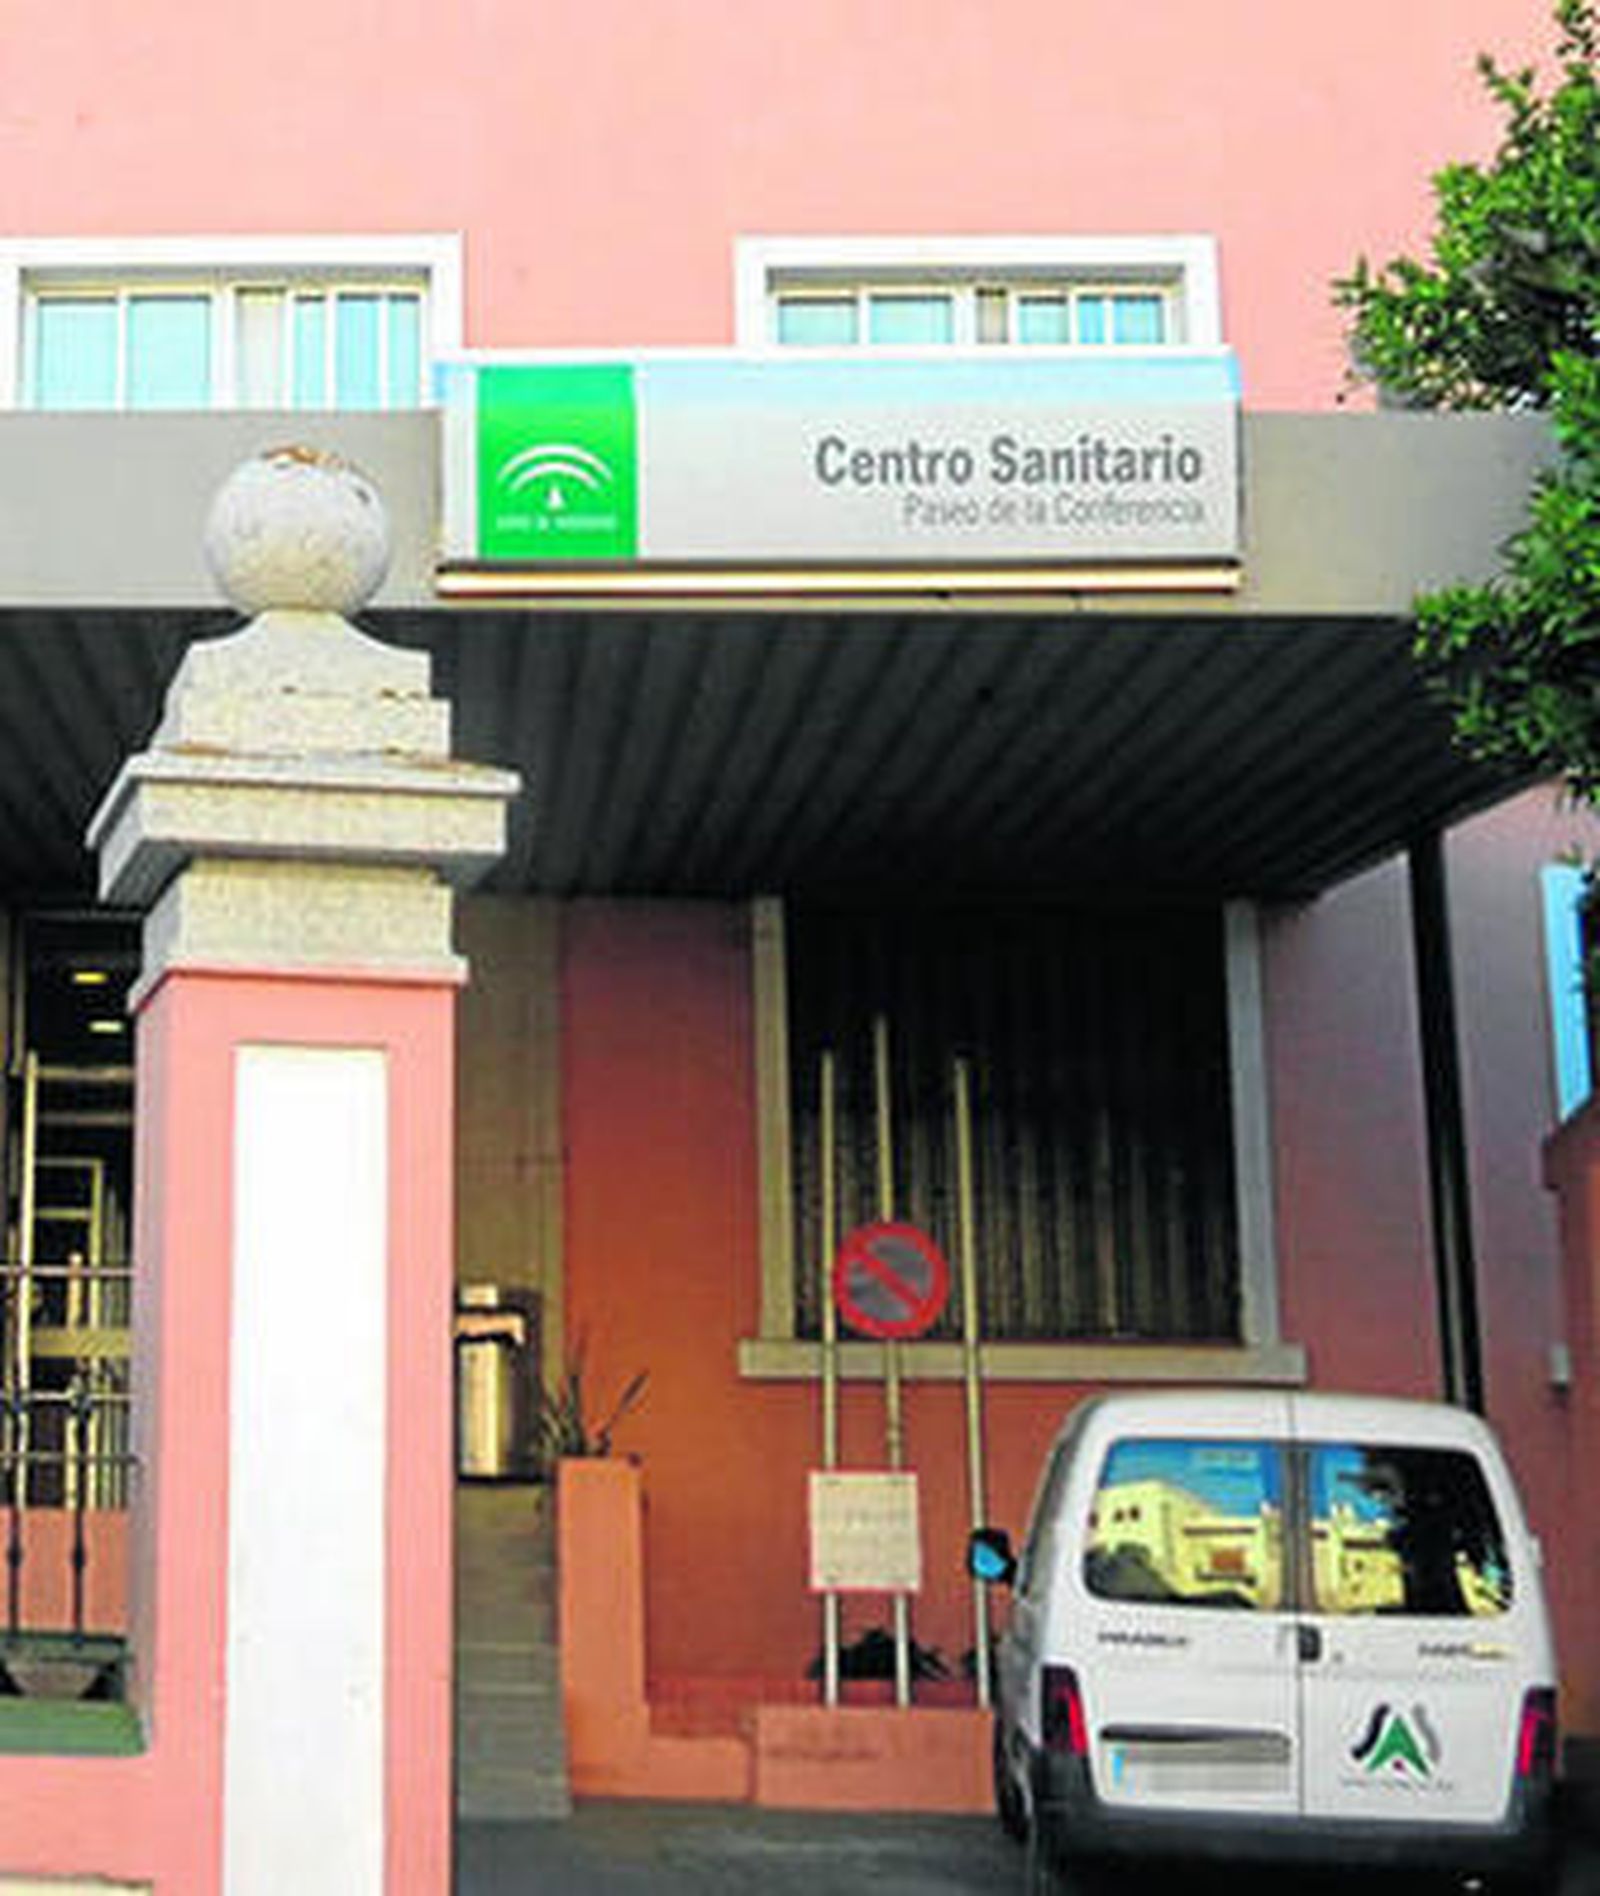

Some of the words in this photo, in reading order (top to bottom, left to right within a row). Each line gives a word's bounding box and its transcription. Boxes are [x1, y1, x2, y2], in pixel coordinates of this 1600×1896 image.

[814, 435, 975, 486] Centro
[989, 434, 1202, 484] Sanitario
[903, 493, 979, 526] Paseo
[988, 493, 1018, 525] de
[1024, 493, 1047, 525] la
[1054, 492, 1206, 526] Conferencia
